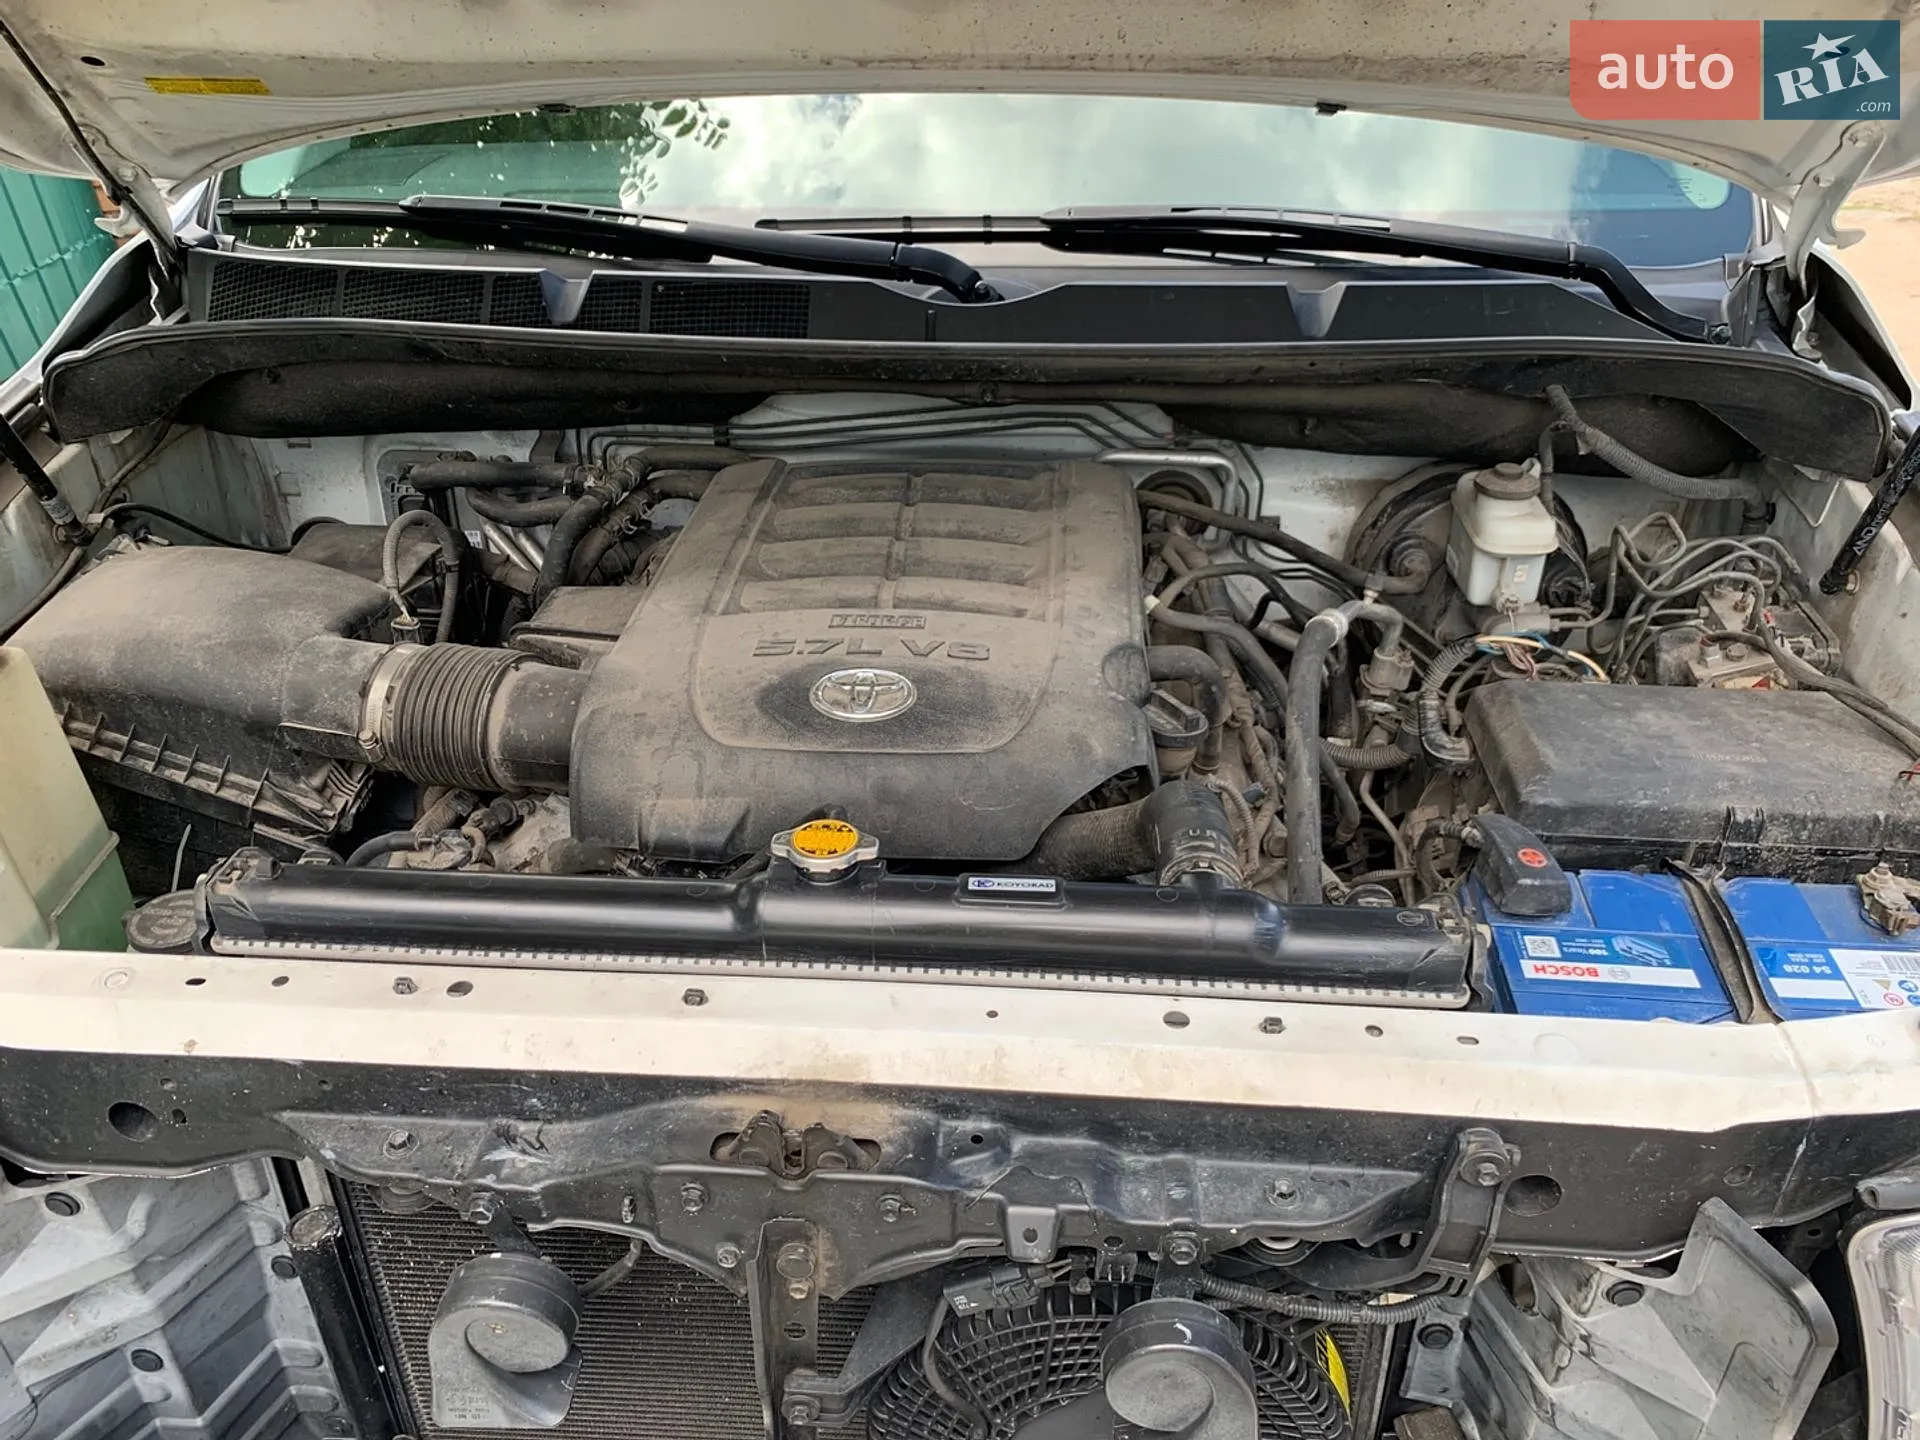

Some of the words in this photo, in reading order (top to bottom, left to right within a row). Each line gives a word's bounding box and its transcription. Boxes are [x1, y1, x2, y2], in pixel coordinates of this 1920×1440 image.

[753, 638, 882, 657] 5.7L
[901, 639, 990, 661] V8
[1533, 964, 1600, 978] BOSCH
